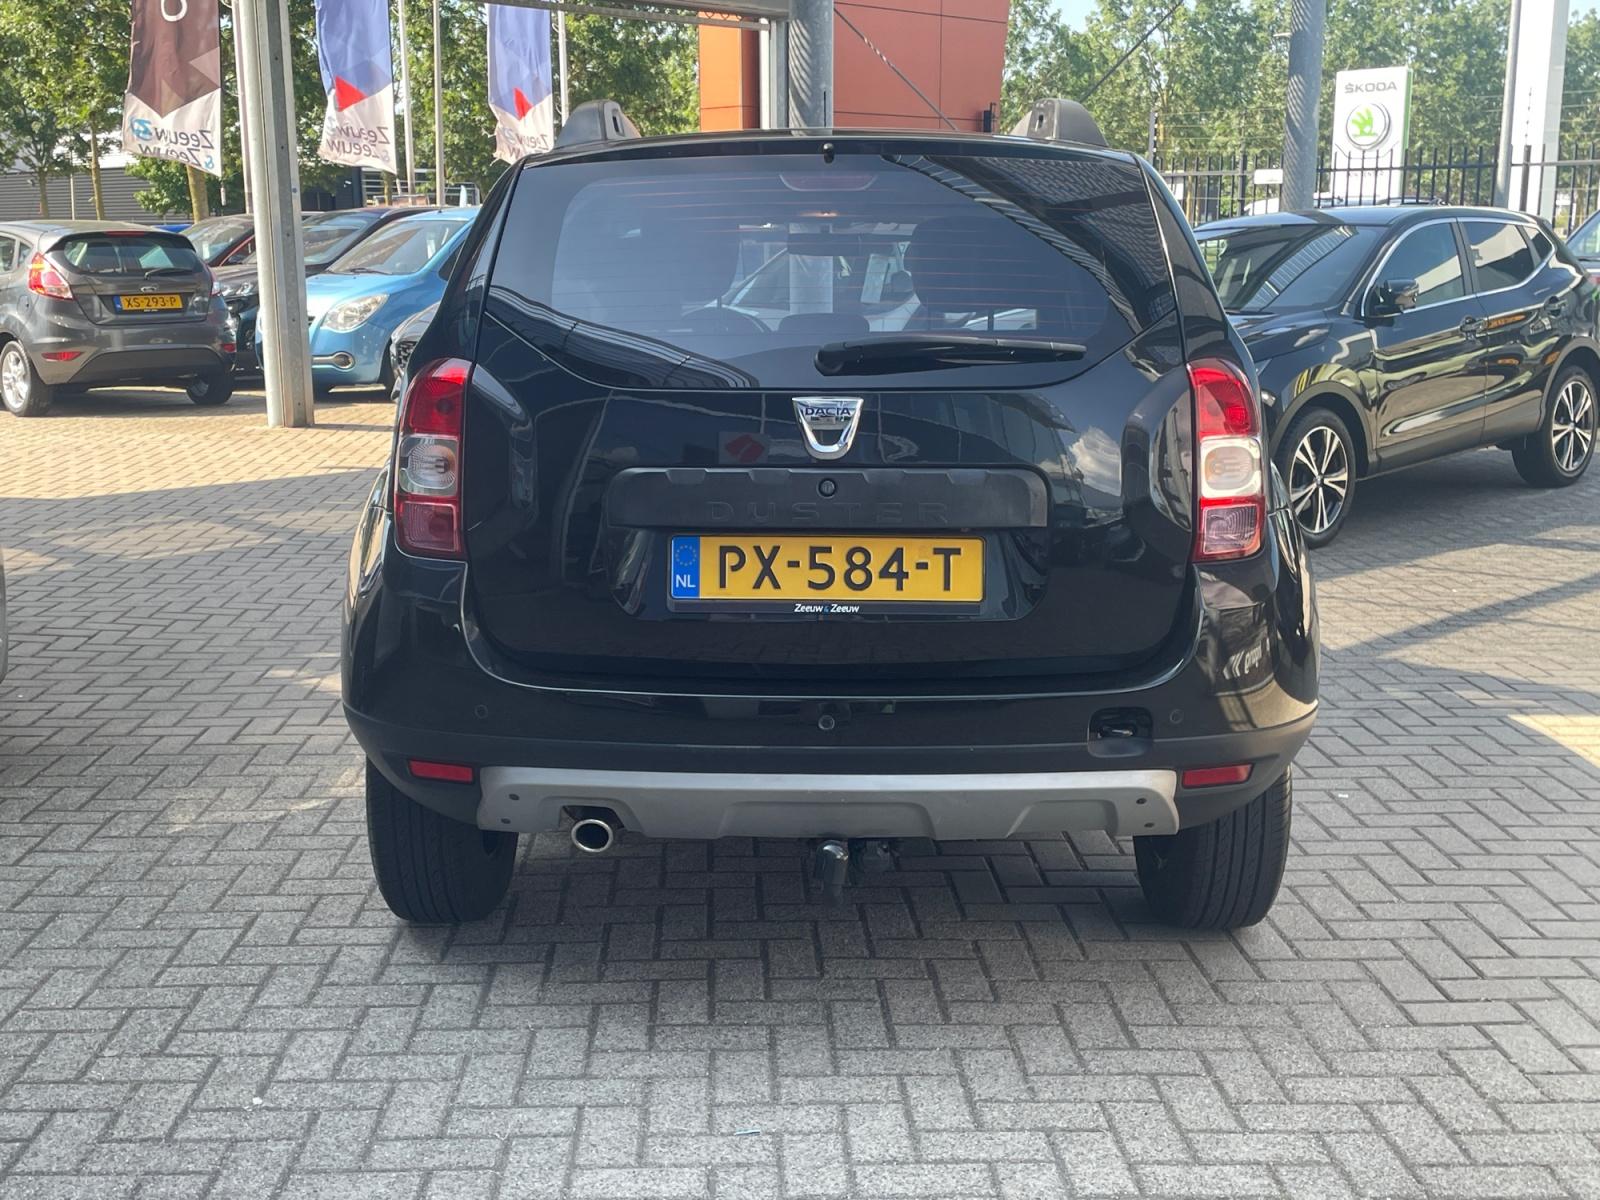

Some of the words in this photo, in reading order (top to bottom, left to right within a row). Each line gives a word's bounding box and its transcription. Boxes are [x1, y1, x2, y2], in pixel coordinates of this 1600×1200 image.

[124, 297, 176, 308] XS-293-P
[805, 407, 851, 416] DACIA
[707, 501, 949, 524] DUSTER
[718, 545, 962, 592] PX-584-T
[675, 574, 697, 588] NL
[794, 603, 824, 613] Zeeuw
[830, 603, 860, 613] Zeeuw
